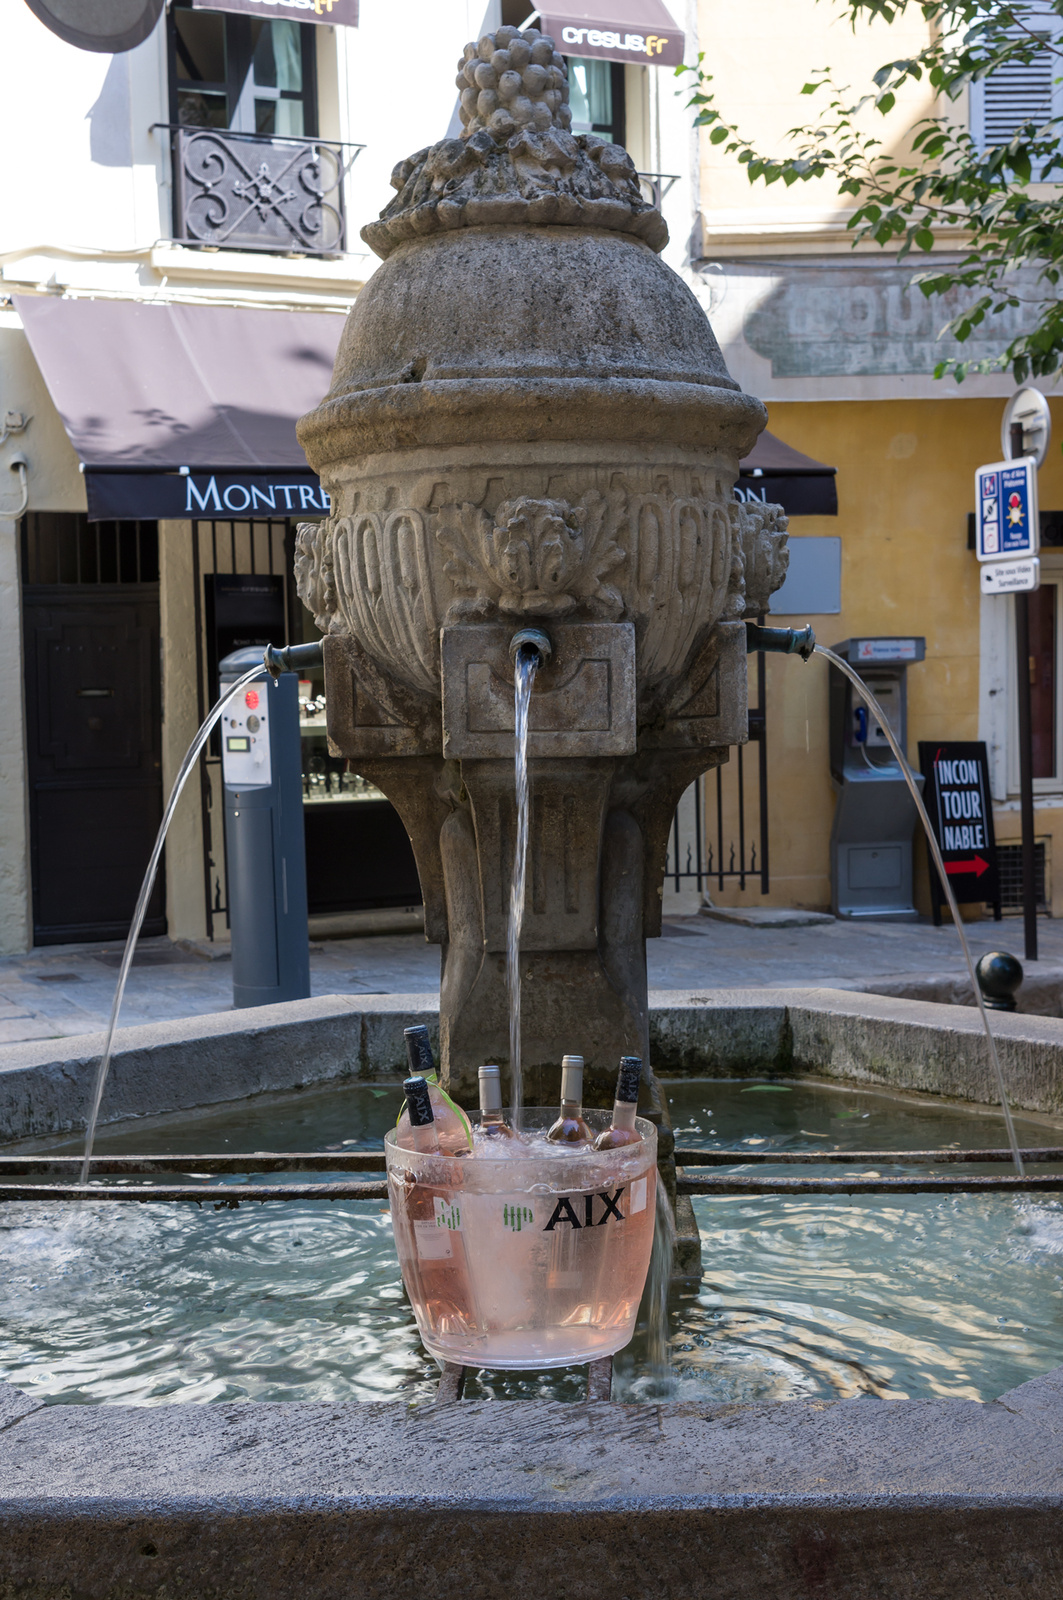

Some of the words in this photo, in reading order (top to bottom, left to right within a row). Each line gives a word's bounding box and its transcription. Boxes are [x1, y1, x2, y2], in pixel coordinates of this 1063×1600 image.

[562, 26, 669, 57] cresus.fr
[998, 577, 1028, 588] Surveillance
[938, 760, 979, 785] INCON
[941, 790, 983, 820] TOUR
[944, 824, 985, 851] NABLE
[418, 1045, 429, 1065] AIX
[415, 1095, 430, 1122] AIX
[543, 1187, 626, 1232] AIX
